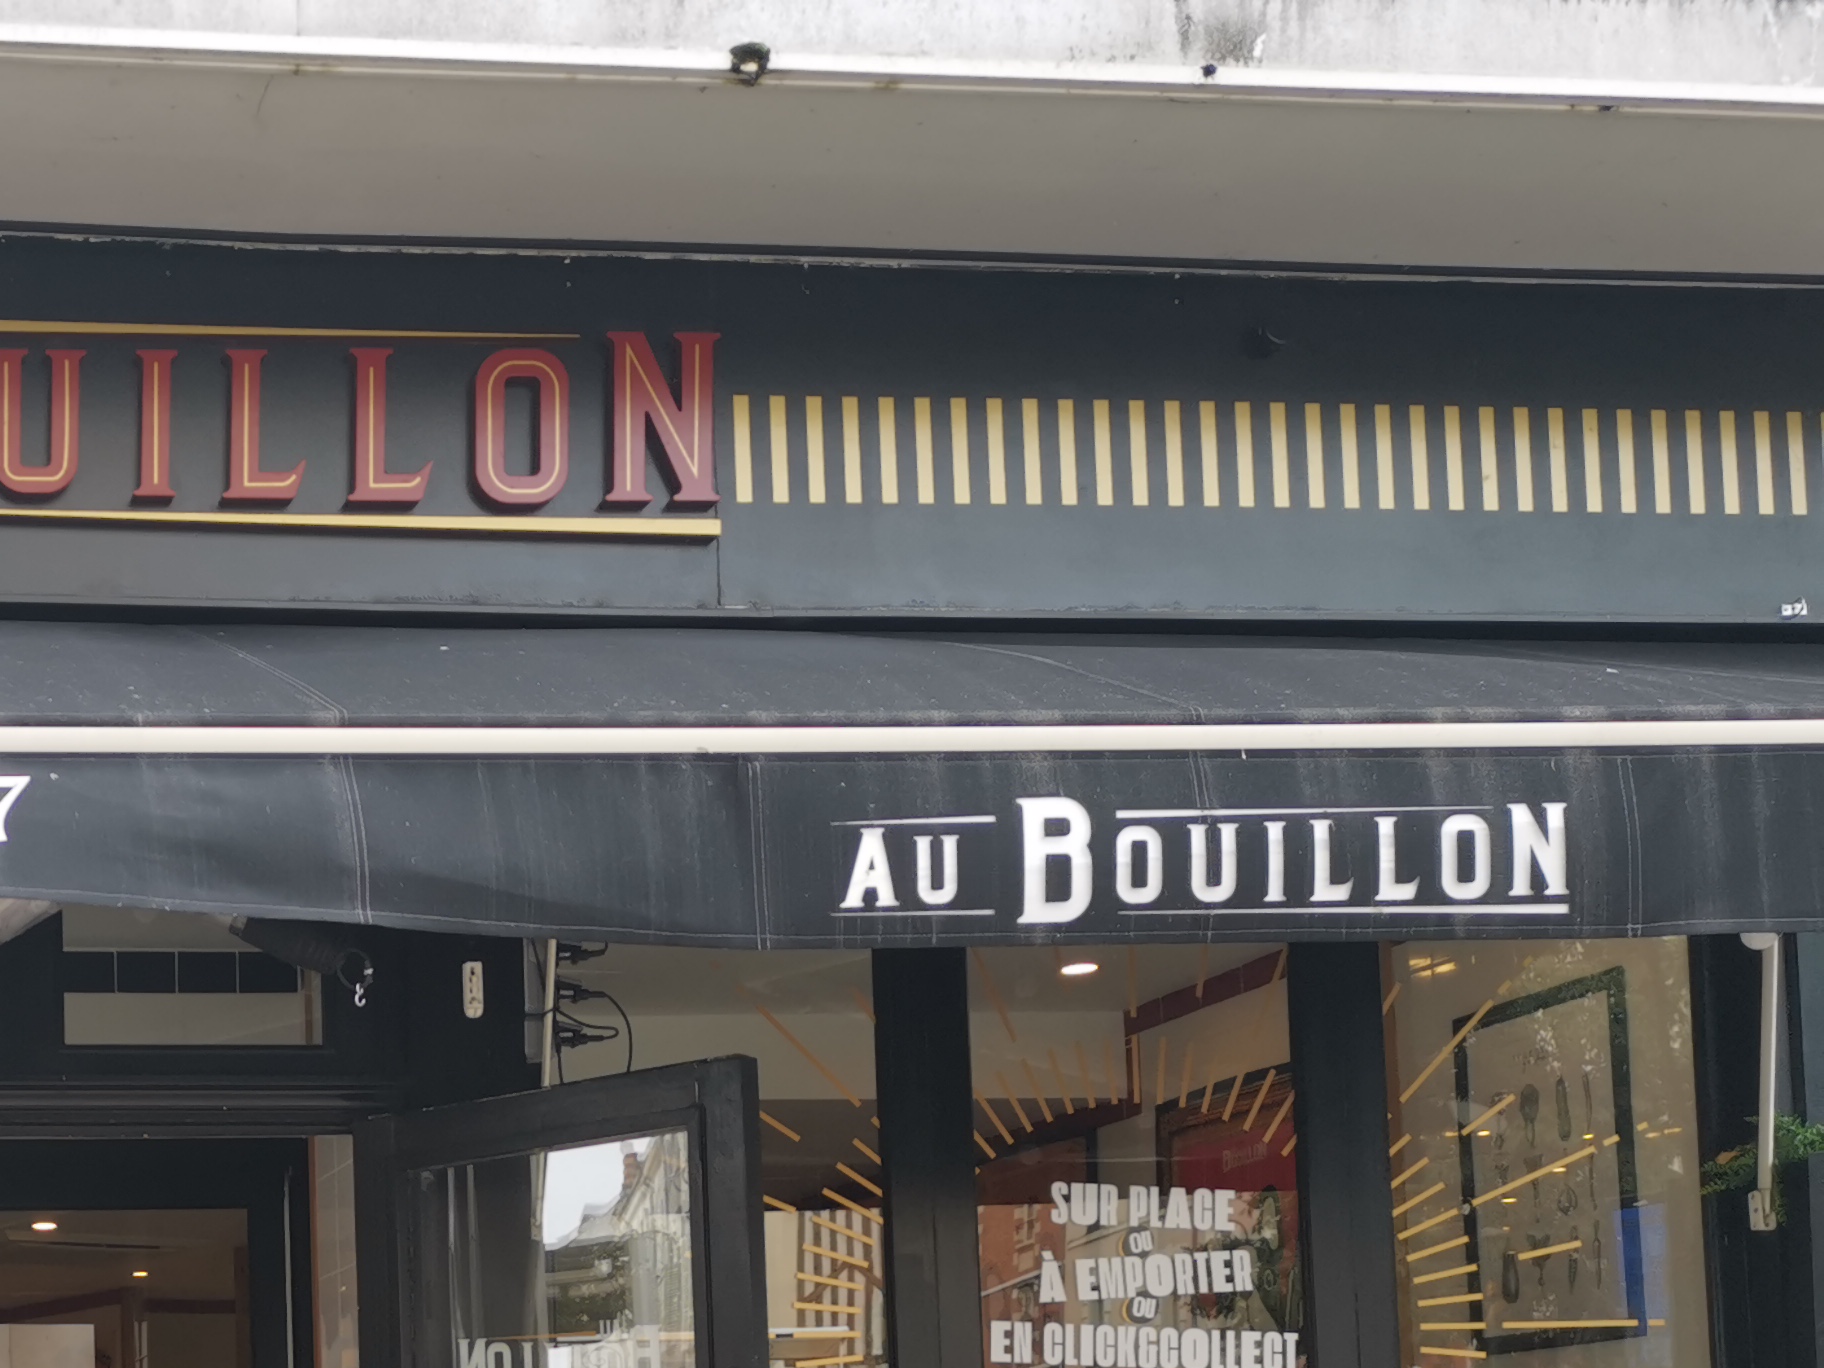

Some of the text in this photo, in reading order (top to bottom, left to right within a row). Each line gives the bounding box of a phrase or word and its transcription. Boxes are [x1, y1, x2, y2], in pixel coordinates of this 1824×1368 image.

[839, 796, 1570, 924] AU BOUILLON
[1050, 1181, 1236, 1231] SUR PLACE
[1129, 1230, 1153, 1252] OU
[1039, 1250, 1254, 1303] À EMPORTER
[1132, 1296, 1157, 1319] OU
[990, 1320, 1033, 1364] EN
